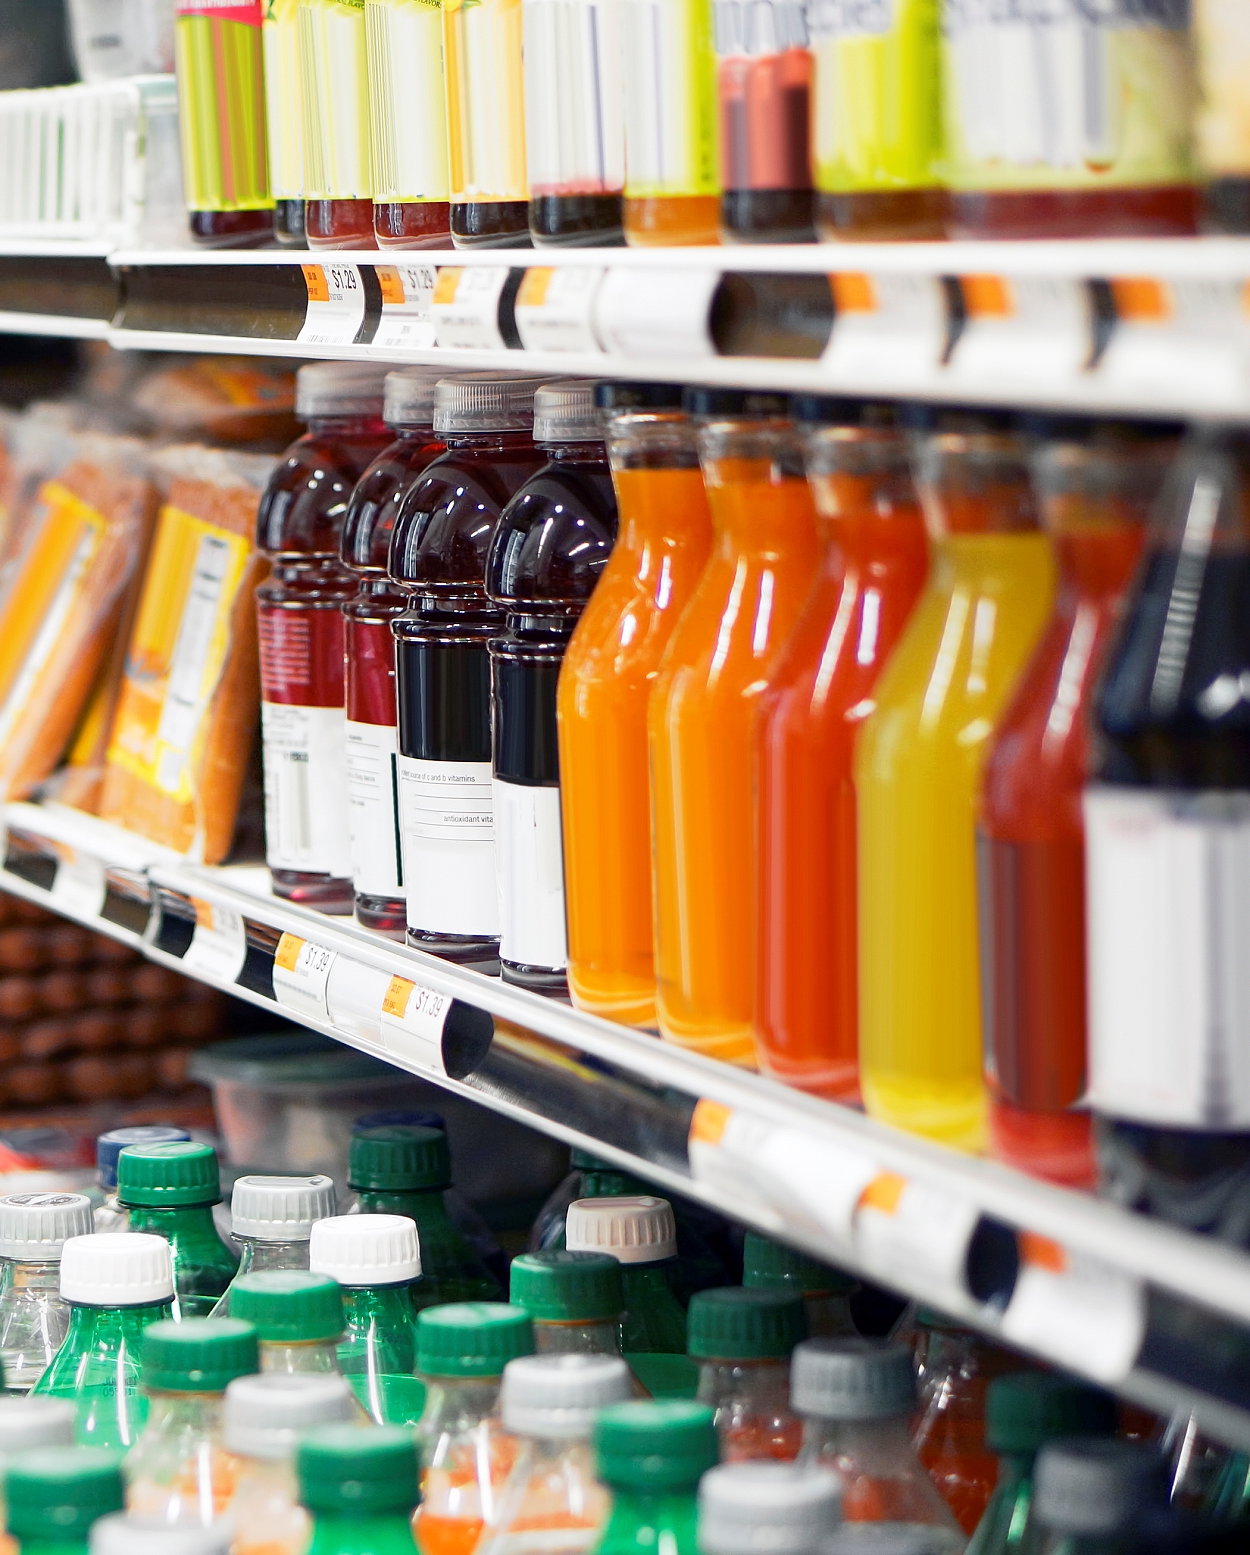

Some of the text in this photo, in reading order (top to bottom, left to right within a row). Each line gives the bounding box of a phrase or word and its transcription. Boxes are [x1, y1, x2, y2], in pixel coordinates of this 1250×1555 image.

[331, 268, 357, 290] $1.29
[442, 774, 447, 782] b
[443, 815, 494, 823] antioxidant vita
[305, 947, 330, 972] $1.39
[415, 991, 444, 1018] $1.39
